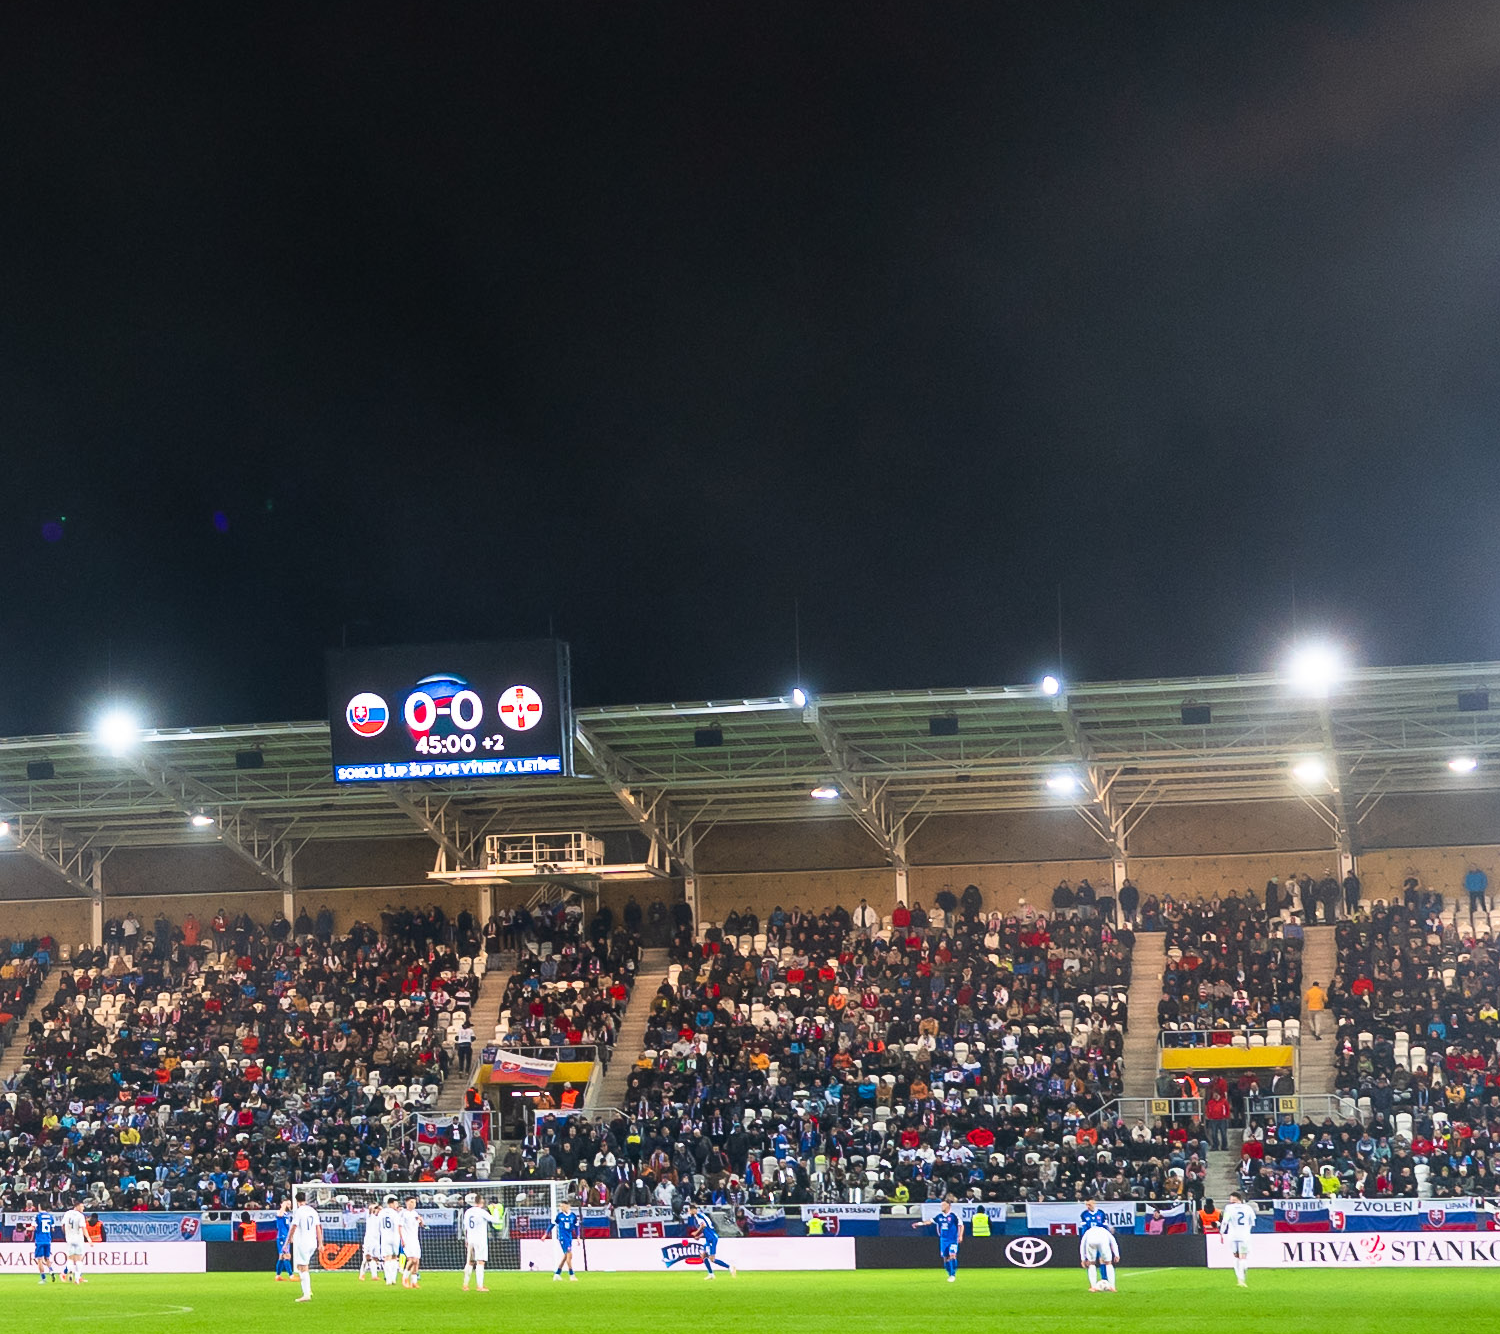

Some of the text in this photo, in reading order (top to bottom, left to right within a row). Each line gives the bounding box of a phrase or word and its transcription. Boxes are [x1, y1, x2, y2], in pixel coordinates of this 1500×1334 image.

[404, 689, 483, 732] 0-0
[415, 733, 504, 754] 45:00 +2
[338, 767, 382, 780] SOKOLI
[505, 762, 516, 773] A
[1154, 1101, 1167, 1112] B2
[1282, 1100, 1294, 1109] B1
[962, 1207, 1001, 1218] STRKOV
[1354, 1201, 1413, 1212] ZVOLEN
[469, 1216, 475, 1229] 6
[1105, 1209, 1132, 1225] LTÁR
[1237, 1211, 1245, 1225] 2
[145, 1223, 155, 1235] ON
[667, 1243, 706, 1261] Budi
[1282, 1241, 1360, 1262] MRVA
